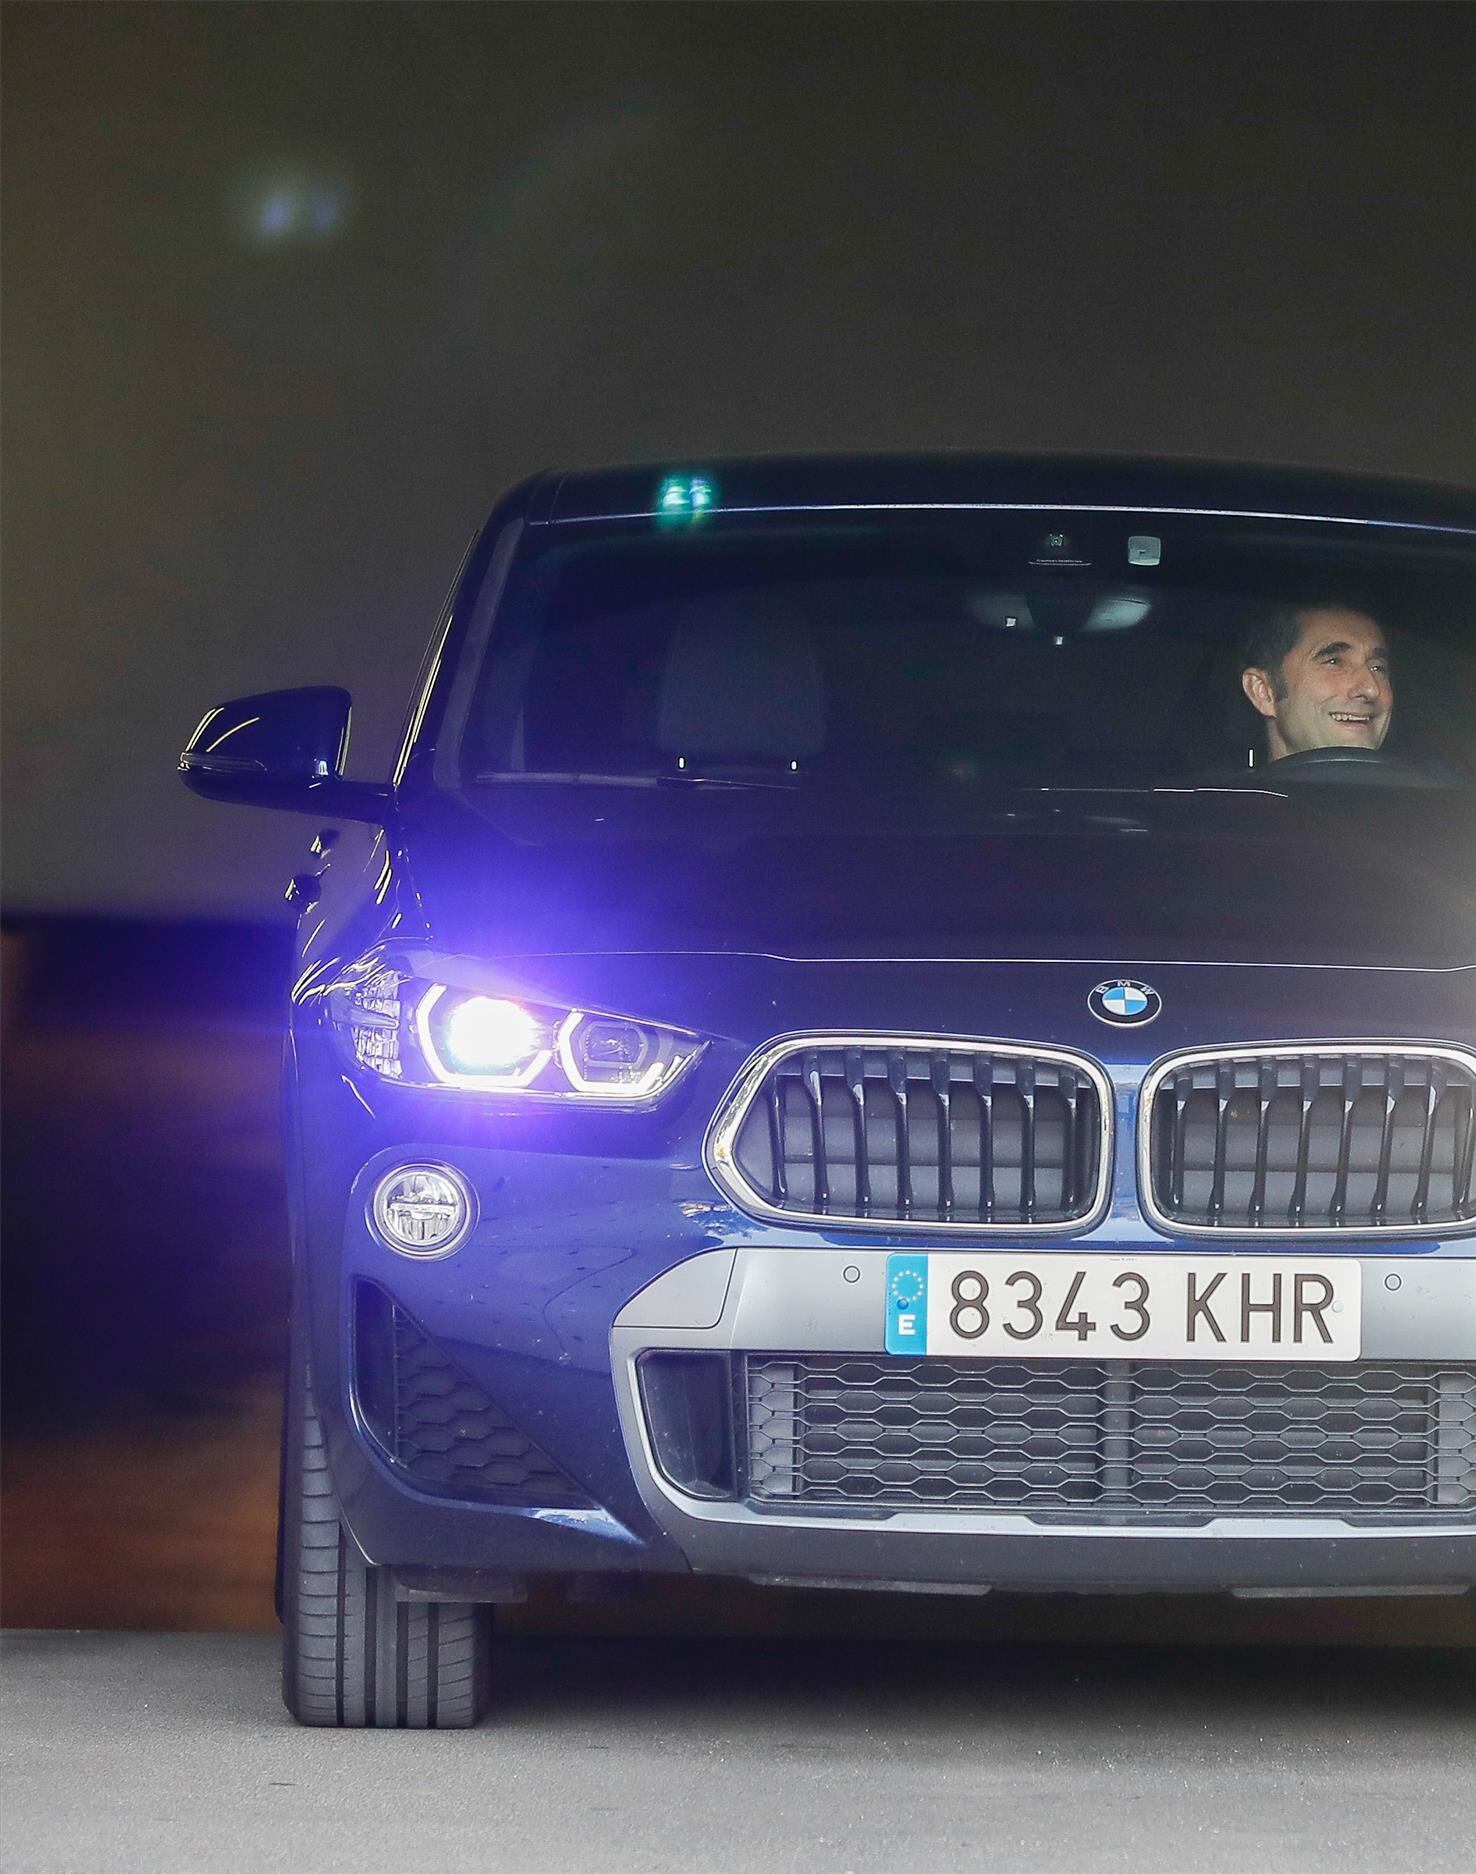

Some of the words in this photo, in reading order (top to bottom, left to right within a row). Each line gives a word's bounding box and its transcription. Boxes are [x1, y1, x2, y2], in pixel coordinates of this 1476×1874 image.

[1095, 980, 1155, 995] BMW
[950, 1270, 1151, 1342] 8343
[1186, 1272, 1335, 1344] KHR
[898, 1314, 916, 1335] E
